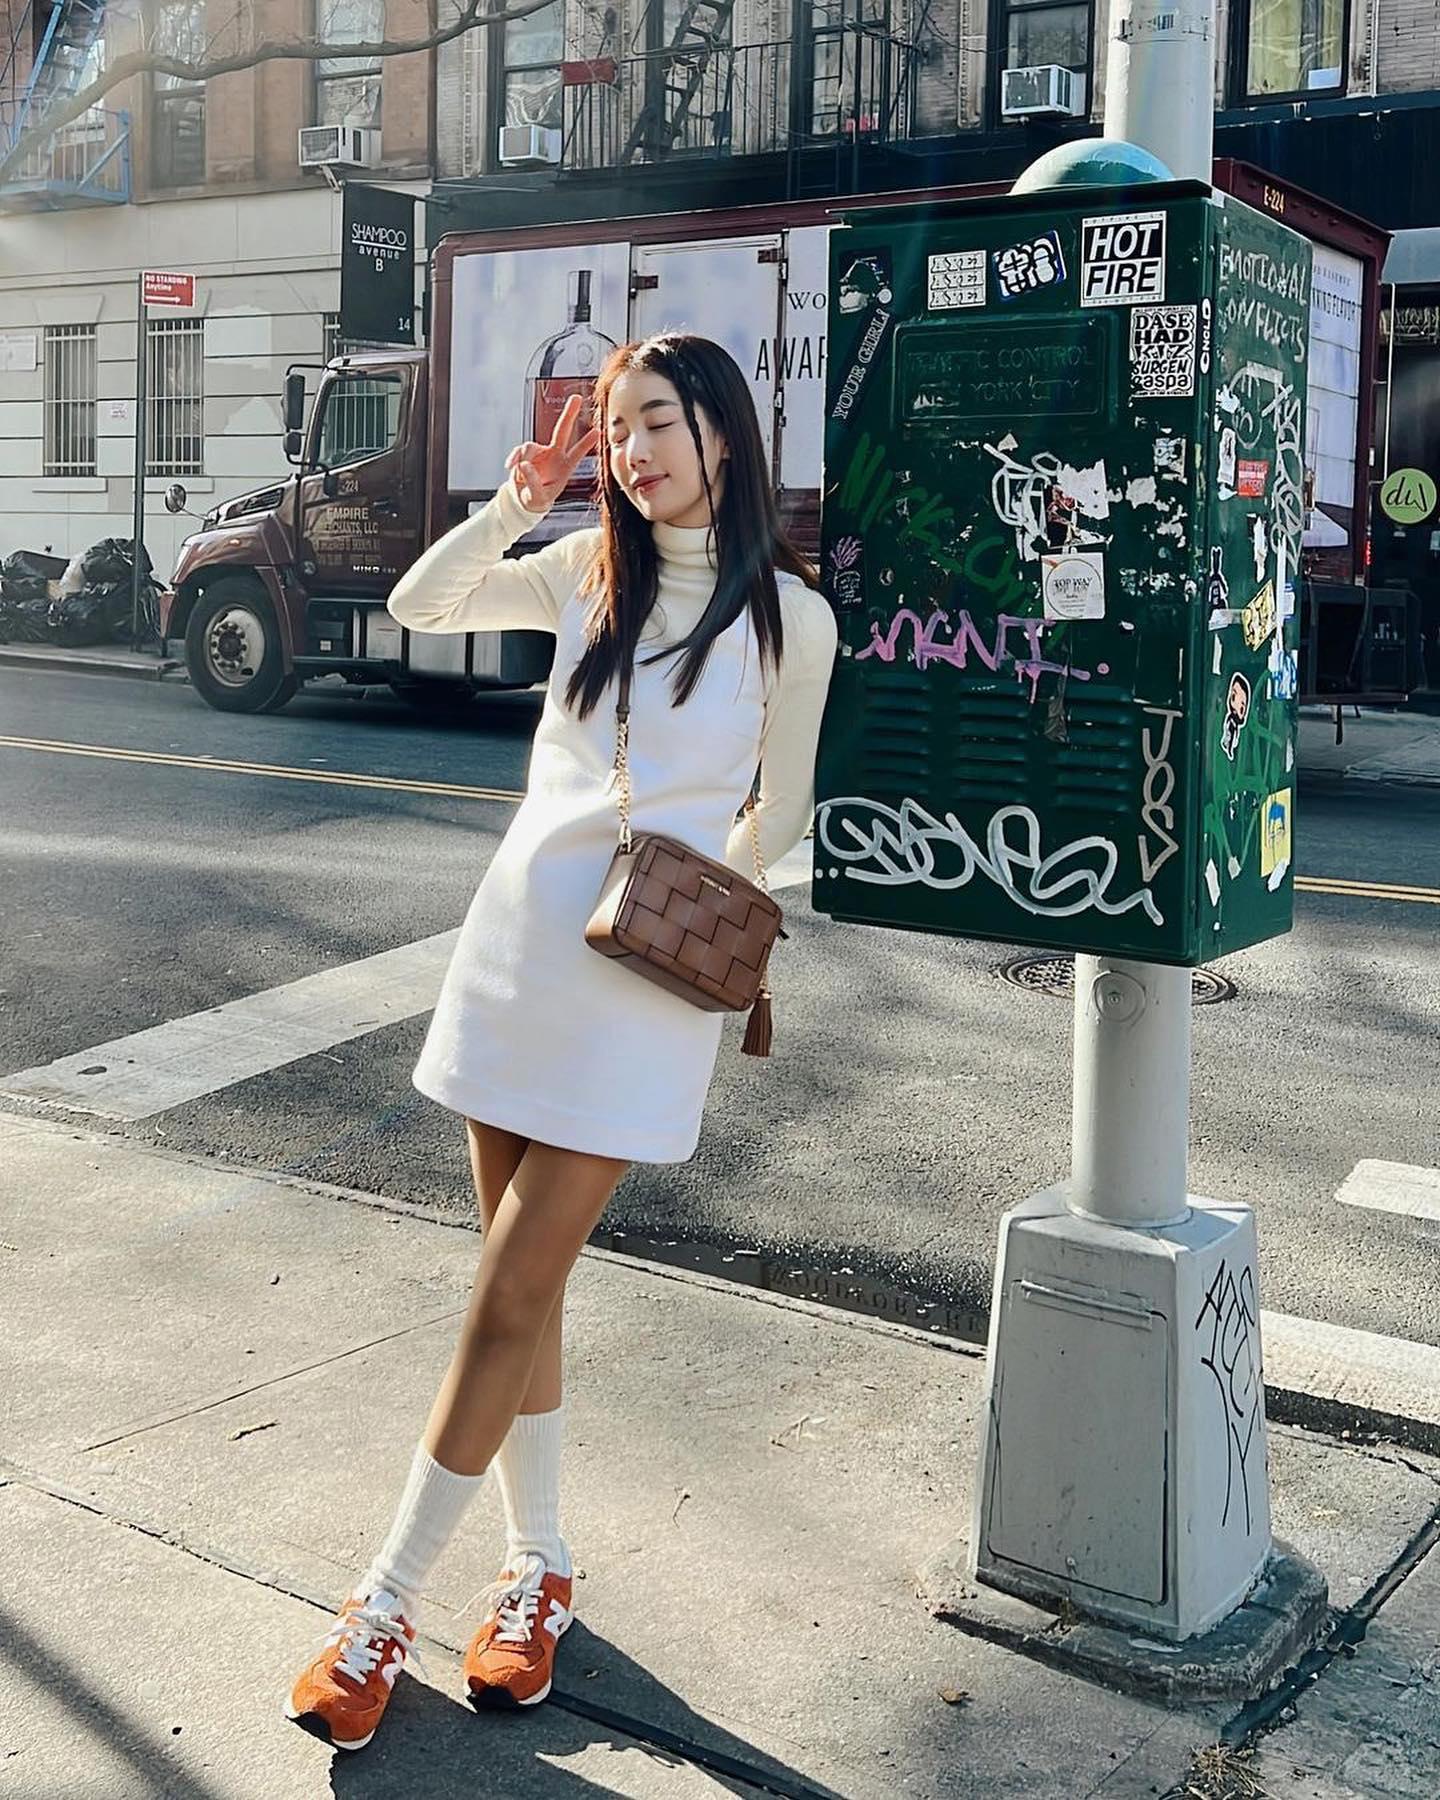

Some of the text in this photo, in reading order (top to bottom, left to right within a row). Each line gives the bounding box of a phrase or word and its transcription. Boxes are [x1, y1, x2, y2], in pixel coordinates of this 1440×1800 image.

[1264, 185, 1284, 214] E-224
[352, 223, 407, 246] SHAMPOO
[1089, 223, 1160, 261] HOT
[358, 244, 400, 260] avenue
[375, 258, 384, 272] B
[146, 274, 156, 283] NO
[1086, 261, 1160, 297] FIRE
[398, 317, 411, 331] 14
[1136, 313, 1190, 329] DASE
[1135, 329, 1190, 345] HAD
[832, 364, 866, 420] YOUR
[340, 480, 359, 493] -224
[327, 507, 369, 520] EMPIRE
[364, 522, 378, 534] LLC
